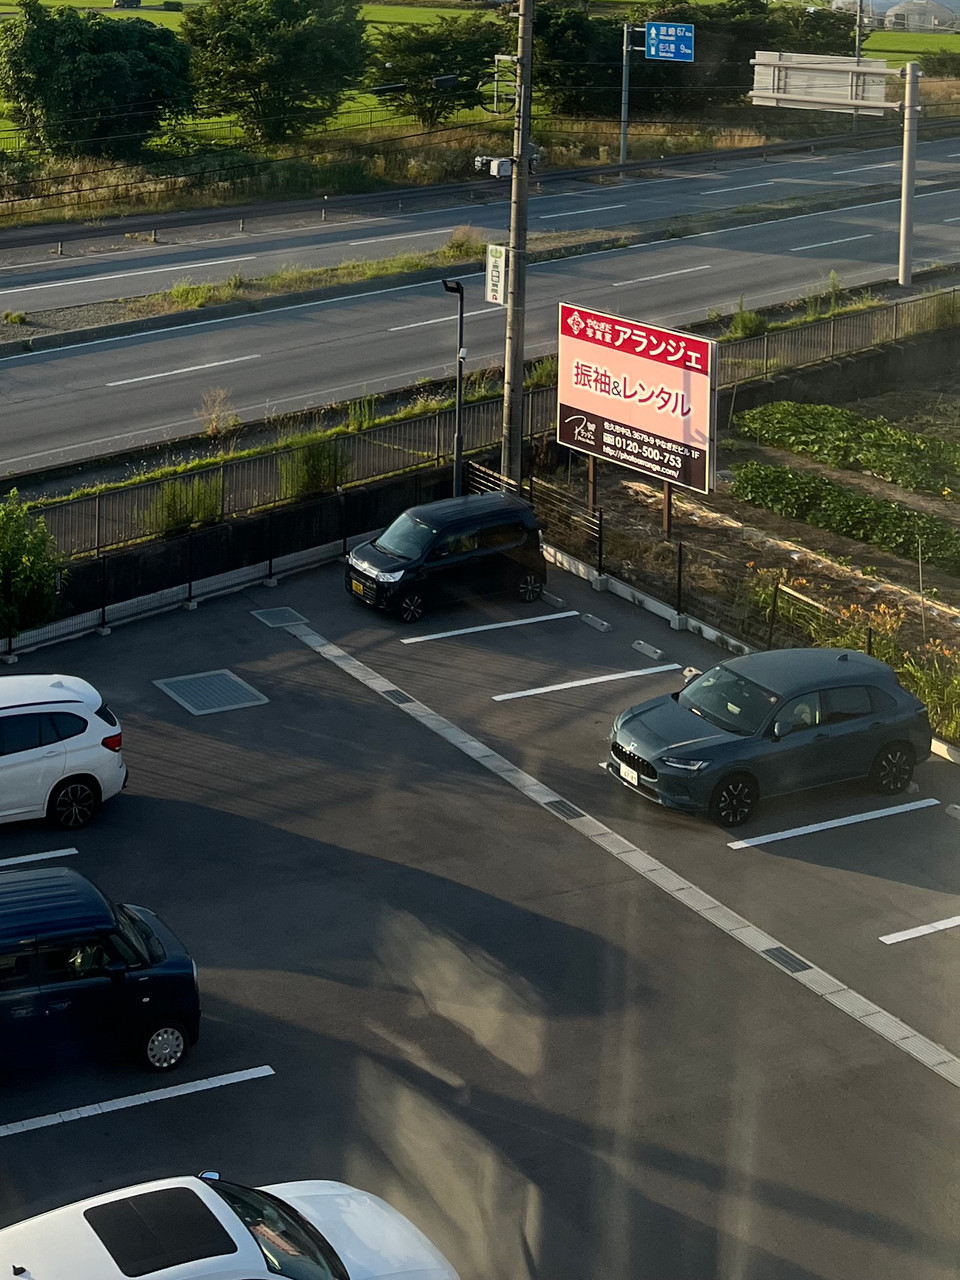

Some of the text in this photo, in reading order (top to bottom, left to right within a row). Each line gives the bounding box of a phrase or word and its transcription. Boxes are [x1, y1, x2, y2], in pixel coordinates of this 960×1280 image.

[677, 27, 685, 36] 67
[680, 44, 685, 53] 9
[586, 319, 612, 333] やなぎだ
[586, 328, 612, 343] 写真室
[614, 325, 702, 369] アランジェ
[574, 361, 691, 417] 振袖&レンタル
[603, 421, 632, 437] 佐久市中込
[632, 431, 655, 444] 3679-9
[655, 438, 690, 456] やなぎだビル
[691, 450, 701, 459] 1F
[615, 438, 682, 469] 0120-500-753
